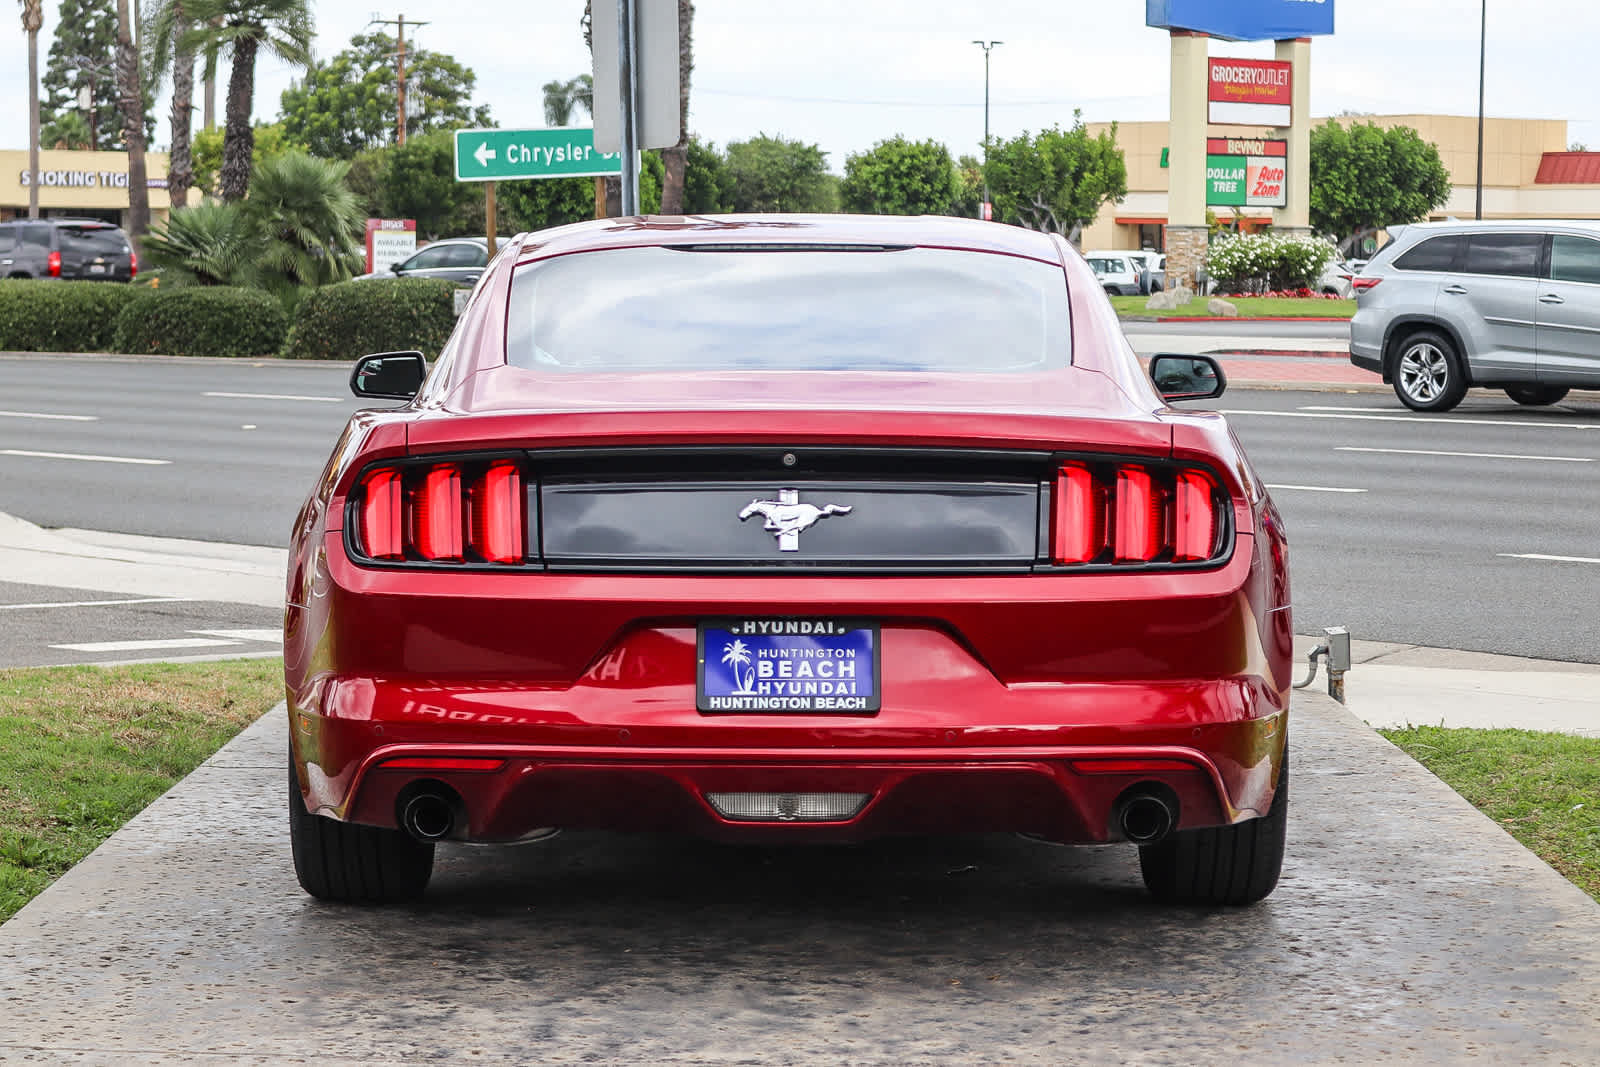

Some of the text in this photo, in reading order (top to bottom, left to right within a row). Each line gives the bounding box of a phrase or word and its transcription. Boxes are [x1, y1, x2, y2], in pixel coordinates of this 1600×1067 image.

[506, 143, 593, 166] Chrysler
[1207, 167, 1246, 180] DOLLAR
[1258, 165, 1284, 181] Auto
[1213, 181, 1238, 193] TREE
[1252, 181, 1280, 196] Zone
[743, 621, 834, 634] HYUNDAI
[758, 648, 856, 659] HUNTINGTON
[757, 660, 856, 678] BEACH
[758, 681, 857, 695] HYUNDAI
[710, 696, 866, 709] HUNTINGTON BEACH
